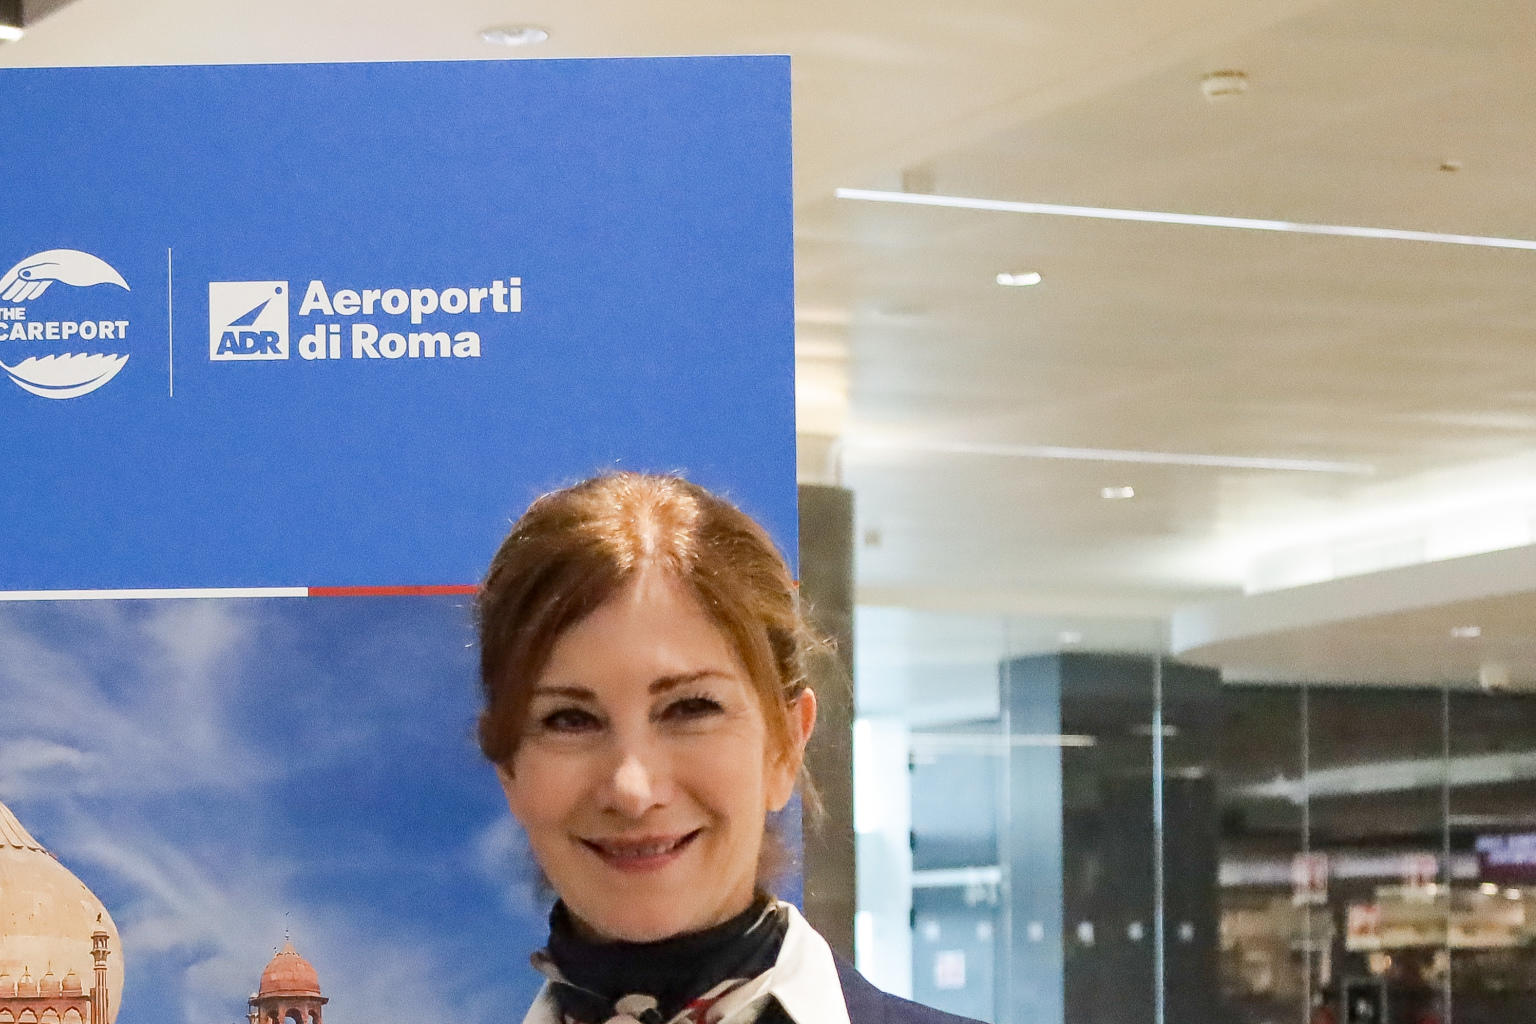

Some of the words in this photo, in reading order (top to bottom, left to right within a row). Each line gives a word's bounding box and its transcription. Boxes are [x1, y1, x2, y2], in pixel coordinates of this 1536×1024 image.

[298, 277, 522, 324] Aeroporti
[216, 330, 283, 356] ADR
[298, 324, 341, 361] di
[351, 323, 482, 359] Roma
